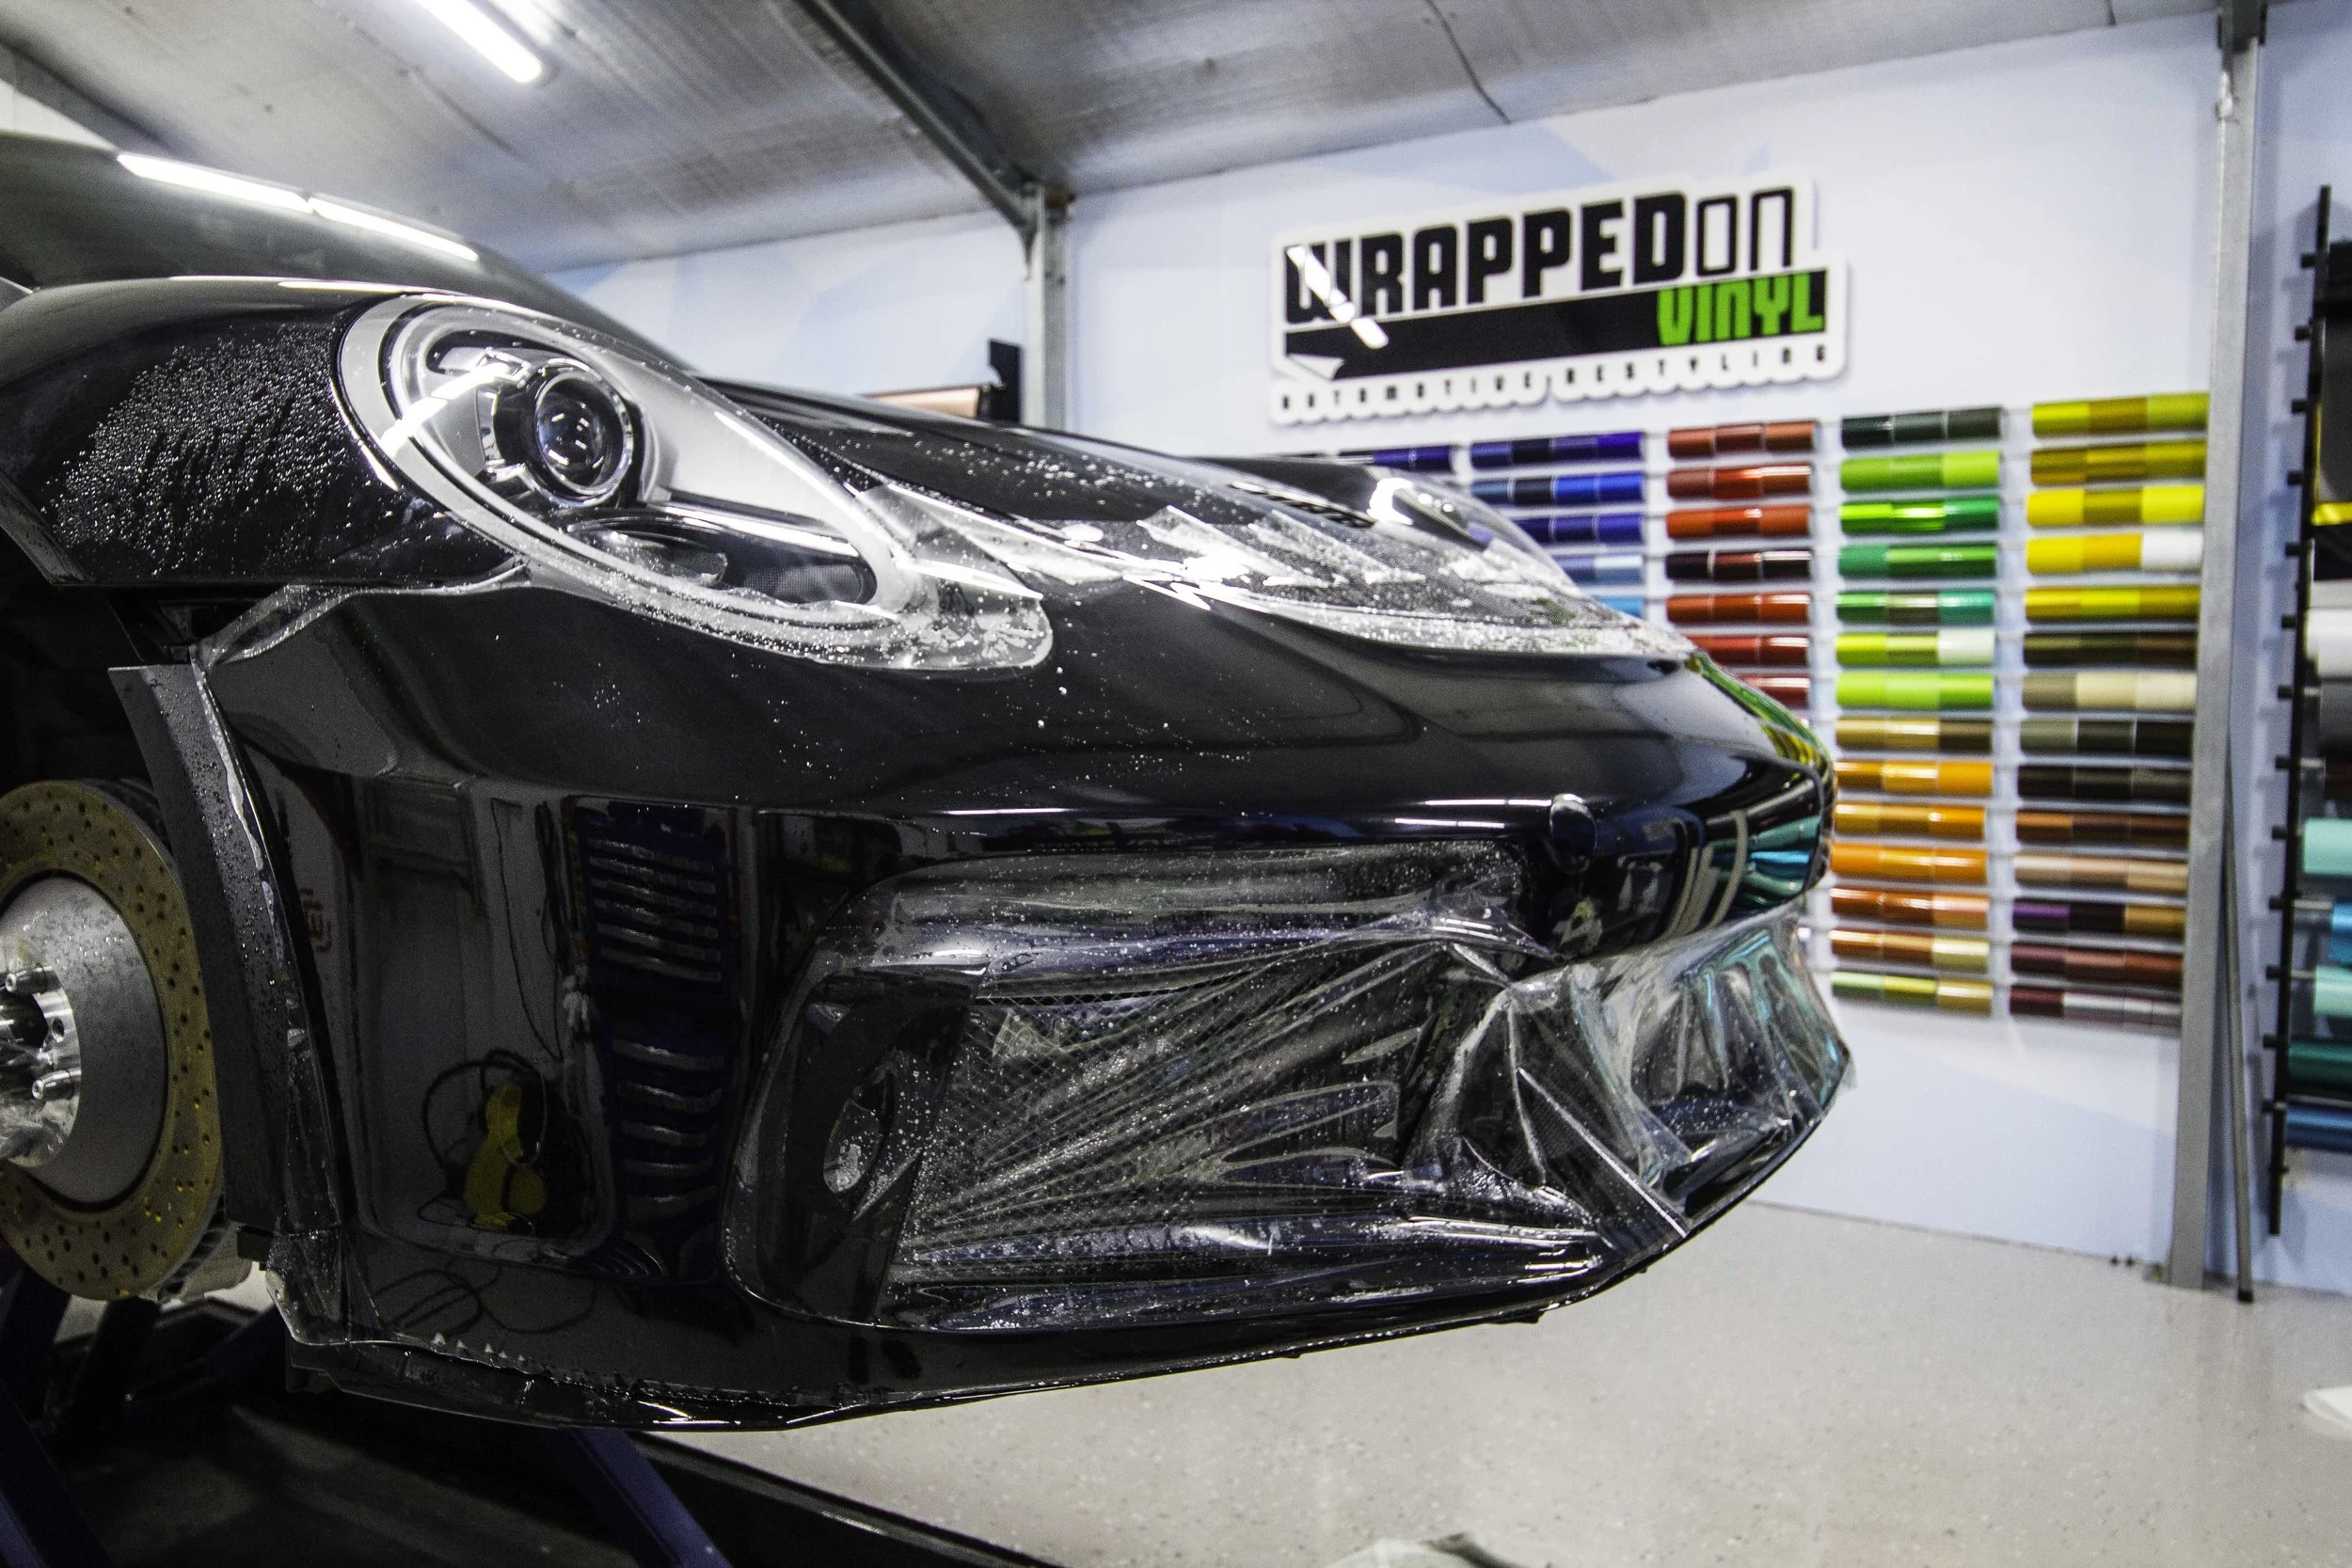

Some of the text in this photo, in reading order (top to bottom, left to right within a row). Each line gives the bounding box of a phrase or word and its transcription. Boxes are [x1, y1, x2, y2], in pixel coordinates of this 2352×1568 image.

[1658, 272, 1825, 346] VINYL
[1282, 344, 1826, 410] AUTOMOTIVE RESTYLING
